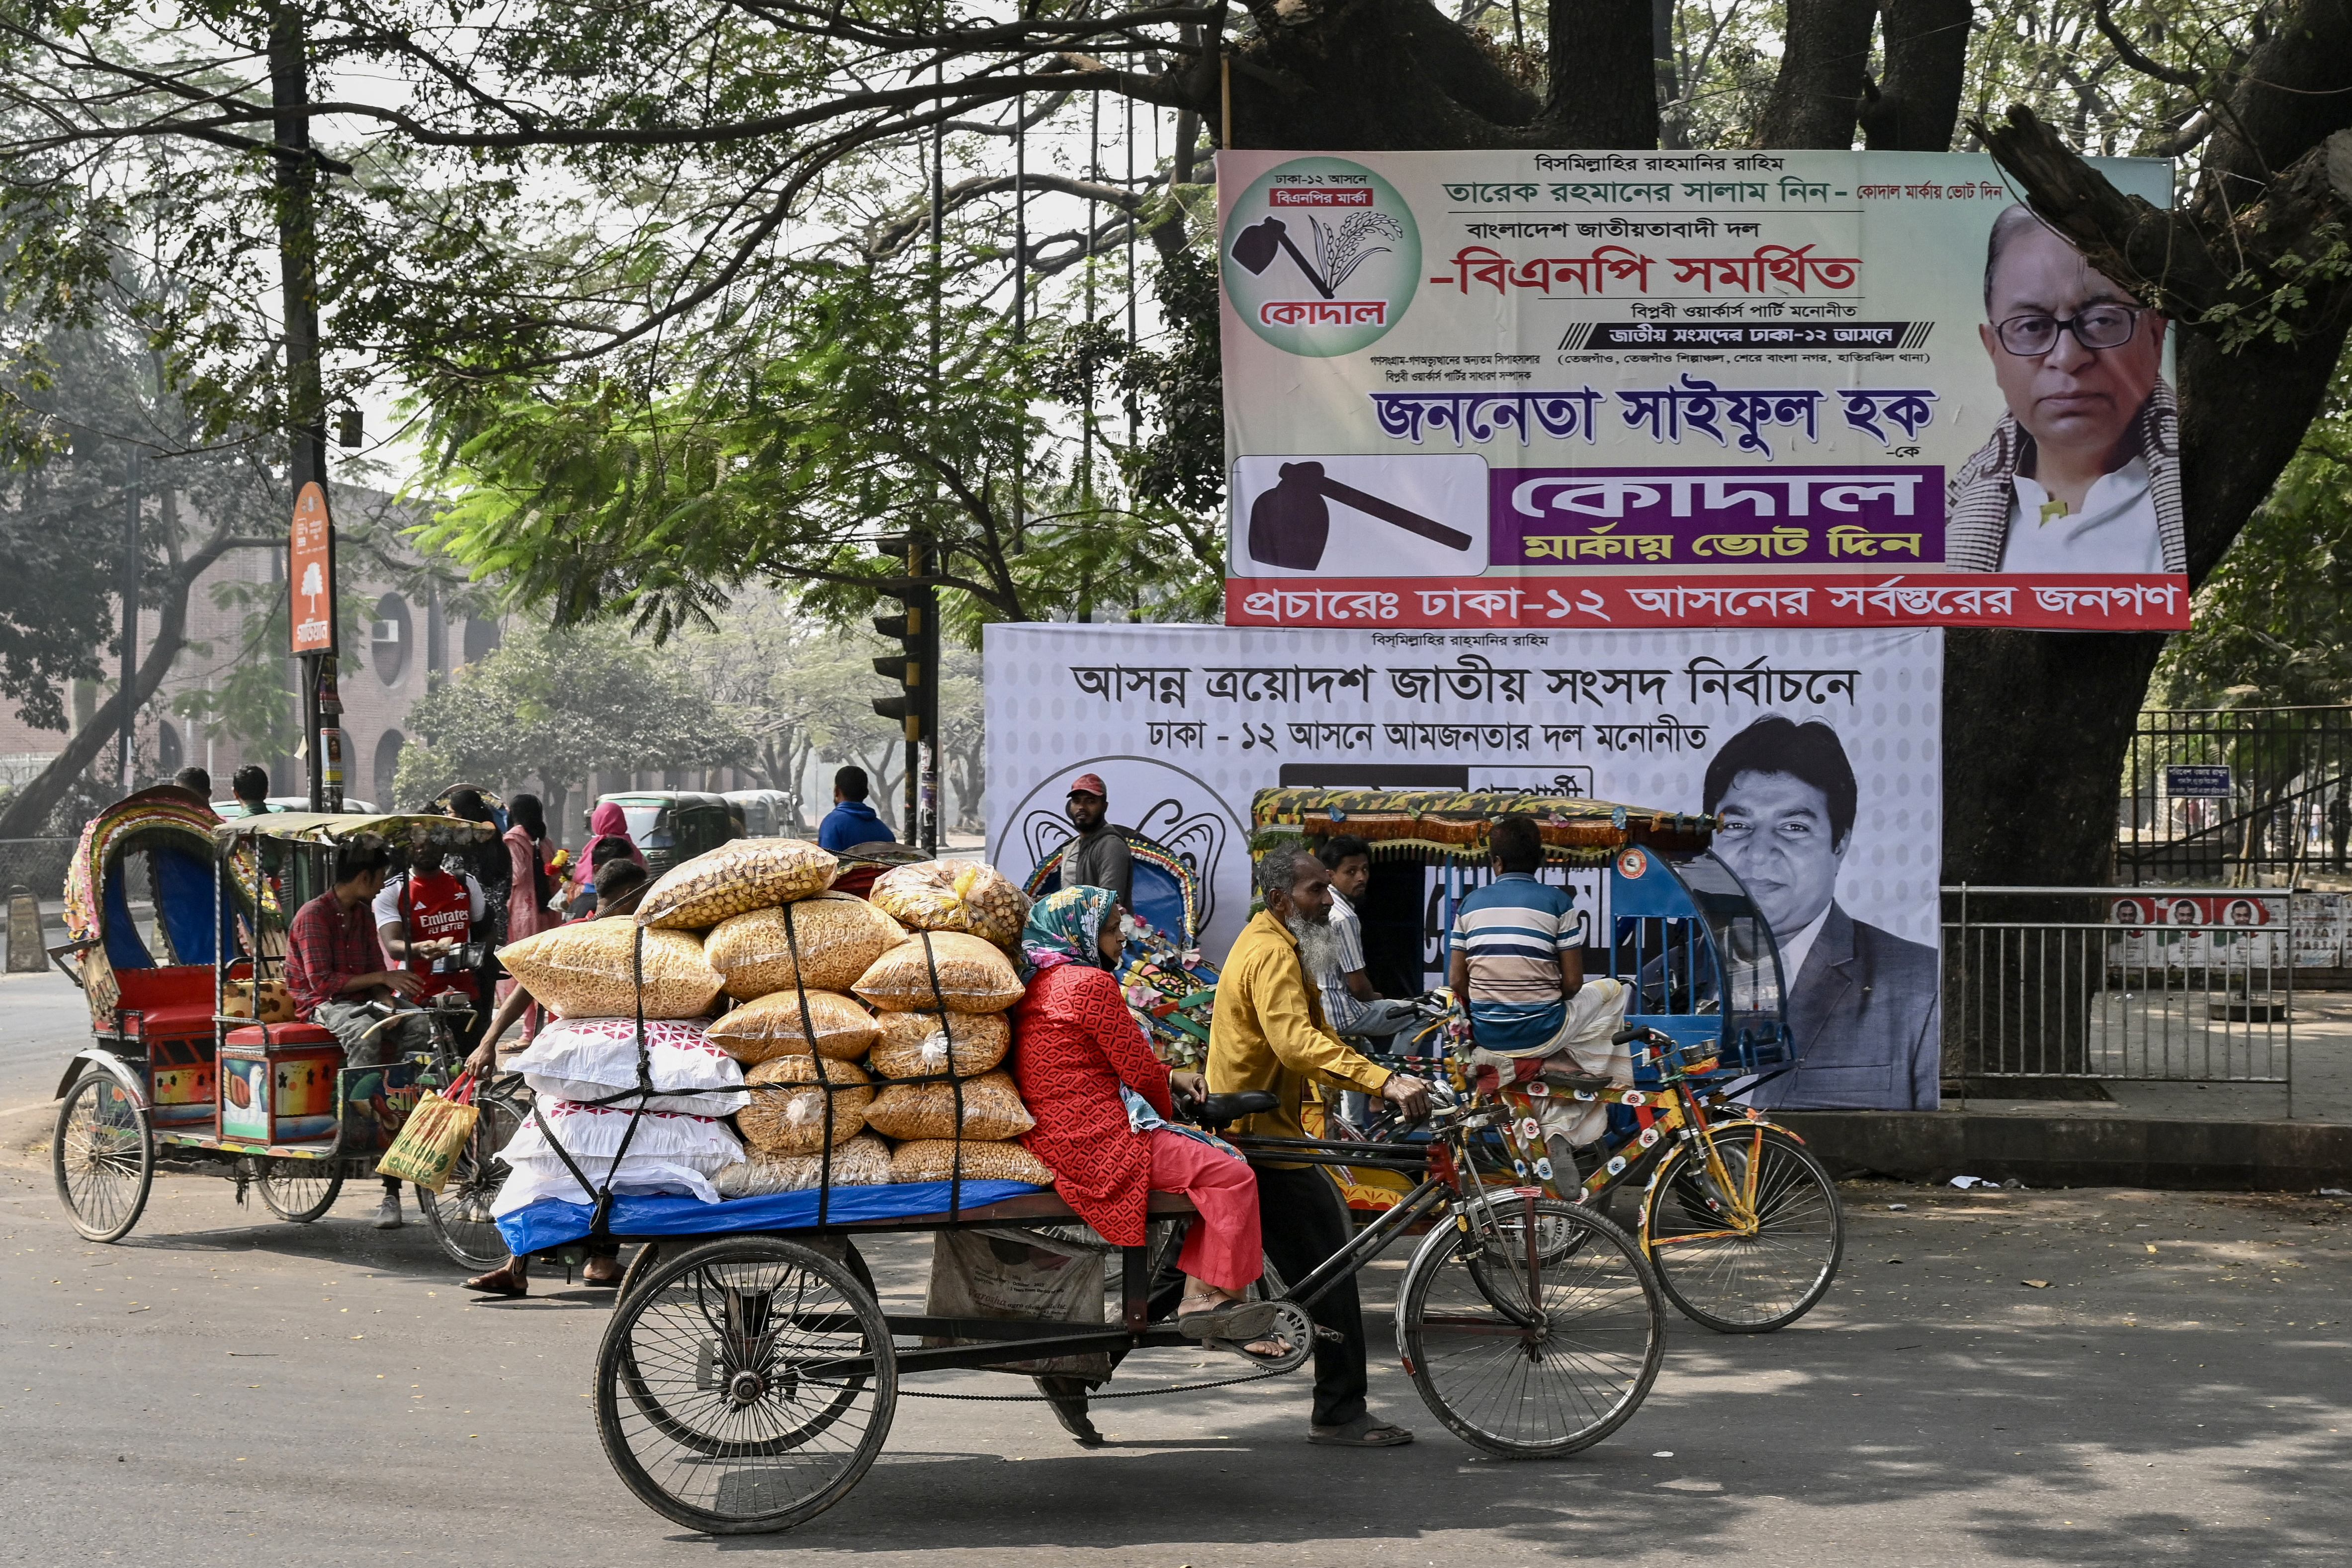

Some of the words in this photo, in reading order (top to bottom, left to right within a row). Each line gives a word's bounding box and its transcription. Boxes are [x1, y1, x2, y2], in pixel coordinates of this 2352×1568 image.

[1533, 153, 1640, 173] বিসমিল্লাহির
[1643, 153, 1728, 172] রাহমানির
[1732, 153, 1786, 172] রাহিম
[1274, 174, 1324, 185] ঢাকা-১২
[1327, 174, 1368, 184] আসনে
[1856, 184, 1902, 199] কোদাল
[1904, 180, 1943, 200] মার্কায়
[1946, 181, 1977, 200] ভোট
[1979, 180, 2004, 200] দিন
[1276, 190, 1333, 204] বিএনপির
[1336, 190, 1368, 204] মার্কা
[1441, 181, 1541, 204] তারেক
[1547, 180, 1675, 204] রহমানের
[1680, 180, 1770, 203] সালাম
[1464, 222, 1571, 240] বাংলাদেশ
[1574, 217, 1720, 238] জাতীয়তাবাদী
[1725, 223, 1762, 238] দল
[1665, 244, 1864, 295] সমর্থিত
[1259, 299, 1389, 327] কোদাল
[1630, 302, 1678, 320] বিপ্লবী
[1682, 302, 1745, 318] ওয়ার্কার্স
[1749, 302, 1786, 318] পার্টি
[1788, 302, 1858, 318] মনোনীত
[1609, 324, 1667, 342] জাতীয়
[1672, 329, 1743, 345] সংসদের
[1748, 329, 1827, 342] ঢাকা-১২
[1832, 329, 1894, 344] আসনে
[1624, 352, 1672, 363] তেজগাঁও
[1734, 354, 1763, 362] শেরে
[1765, 354, 1799, 363] বাংলা
[1836, 351, 1896, 362] হাতিরঝিল
[1366, 384, 1608, 446] জননেতা
[1613, 372, 1828, 461] সাইফুল
[1835, 389, 1940, 446] হক
[1511, 474, 1923, 518] কোদাল
[1522, 522, 1674, 561] মার্কায়
[1692, 525, 1809, 558] ভোট
[1826, 524, 1922, 557] দিন
[1413, 587, 1611, 622] ঢাকা-১২
[1624, 585, 1816, 617] আসনের
[1823, 573, 2019, 616] সর্বস্তরের
[2029, 583, 2182, 616] জনগণ
[1511, 633, 1550, 647] রাহিম
[1068, 663, 1193, 709] আসন্ন
[1202, 663, 1378, 703] ত্রয়োদশ
[1385, 653, 1533, 704] জাতীয়
[1541, 669, 1673, 708] সংসদ
[1682, 655, 1862, 707] নির্বাচনে
[1145, 719, 1208, 750] ঢাকা
[1241, 722, 1278, 753] ১২
[1286, 720, 1377, 751] আসনে
[1382, 720, 1534, 752] আমজনতার
[1539, 724, 1586, 752] দল
[1592, 713, 1710, 753] মনোনীত
[419, 910, 469, 928] Emirates
[440, 922, 464, 932] BETTER
